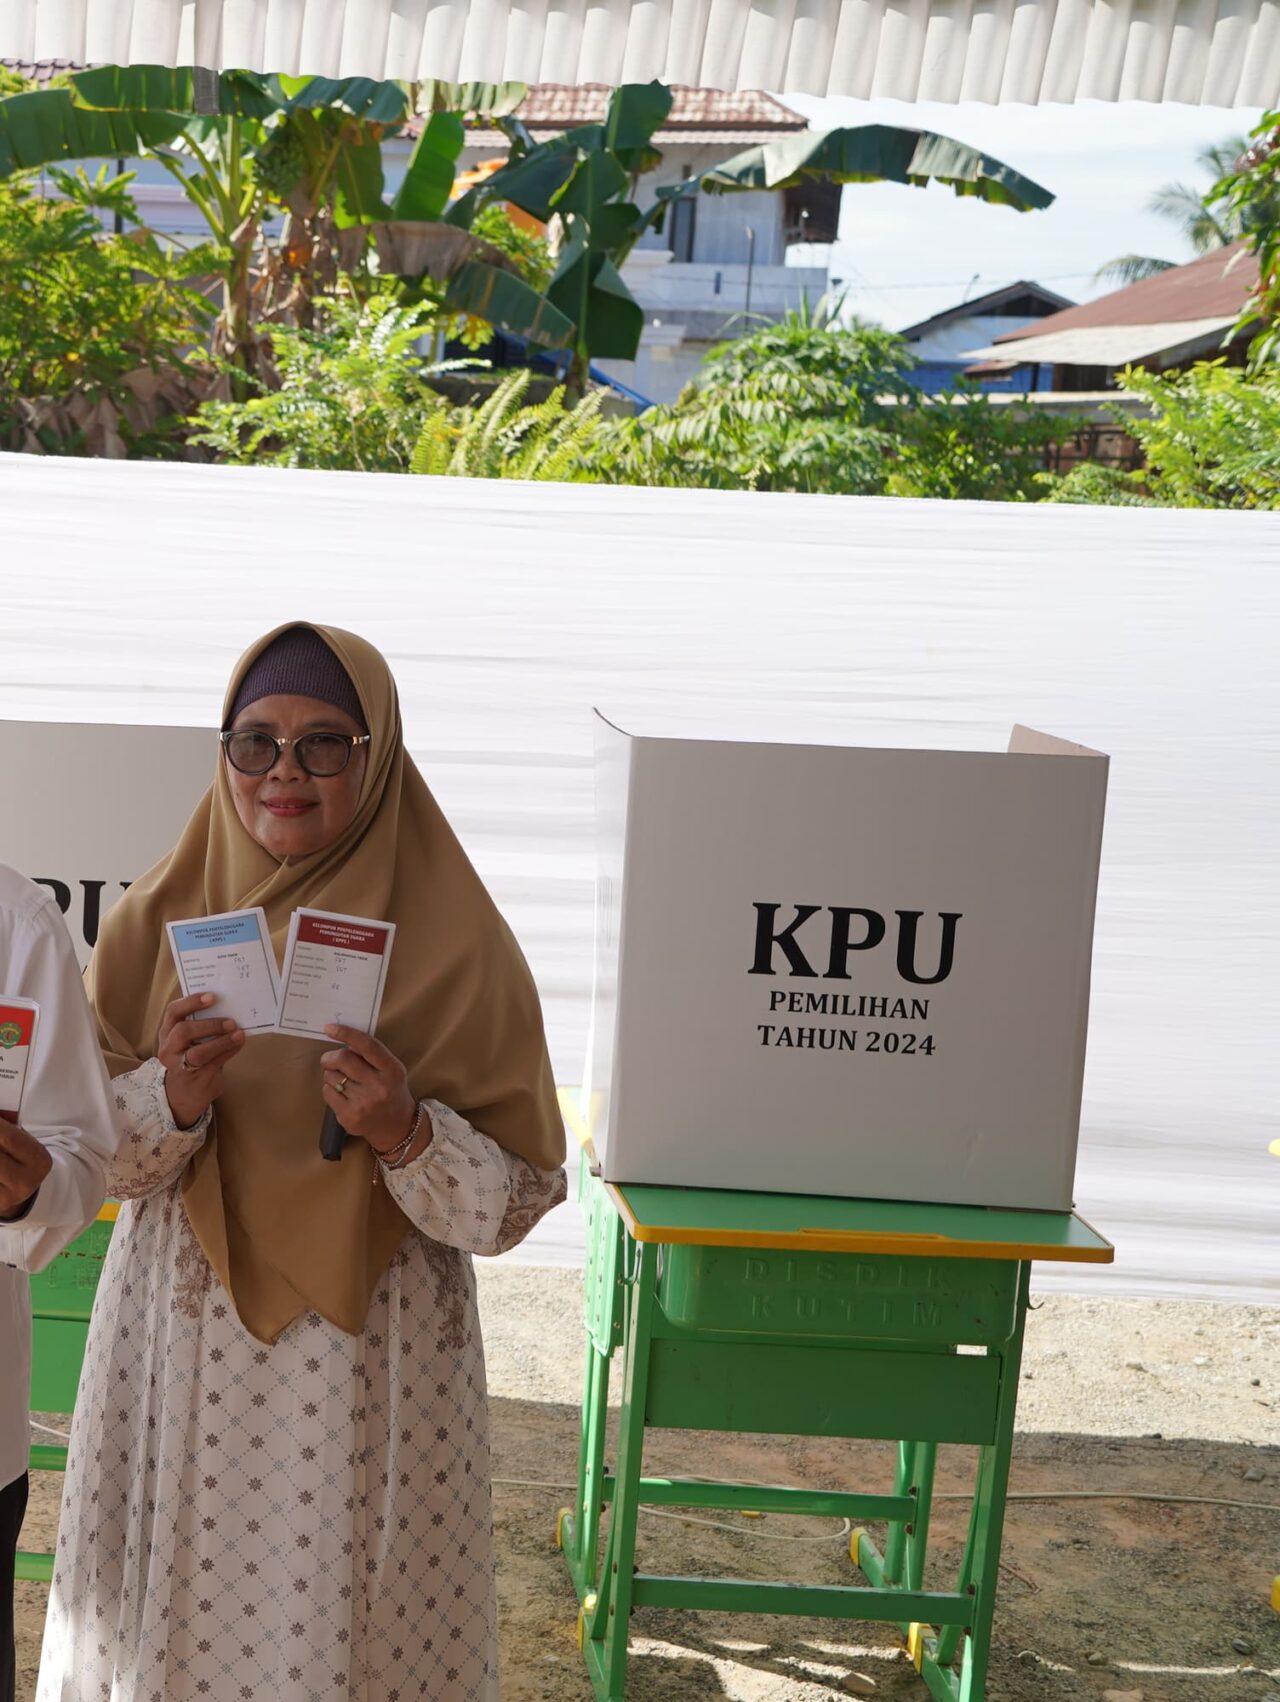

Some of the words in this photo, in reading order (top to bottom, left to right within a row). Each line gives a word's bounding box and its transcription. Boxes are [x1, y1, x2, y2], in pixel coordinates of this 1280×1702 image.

[30, 878, 133, 948] PU
[748, 902, 963, 985] KPU
[768, 991, 930, 1020] PEMILIHAN
[757, 1025, 857, 1051] TAHUN
[865, 1031, 936, 1055] 2024
[745, 1258, 958, 1289] DISDIK
[752, 1296, 947, 1327] KUTIM
